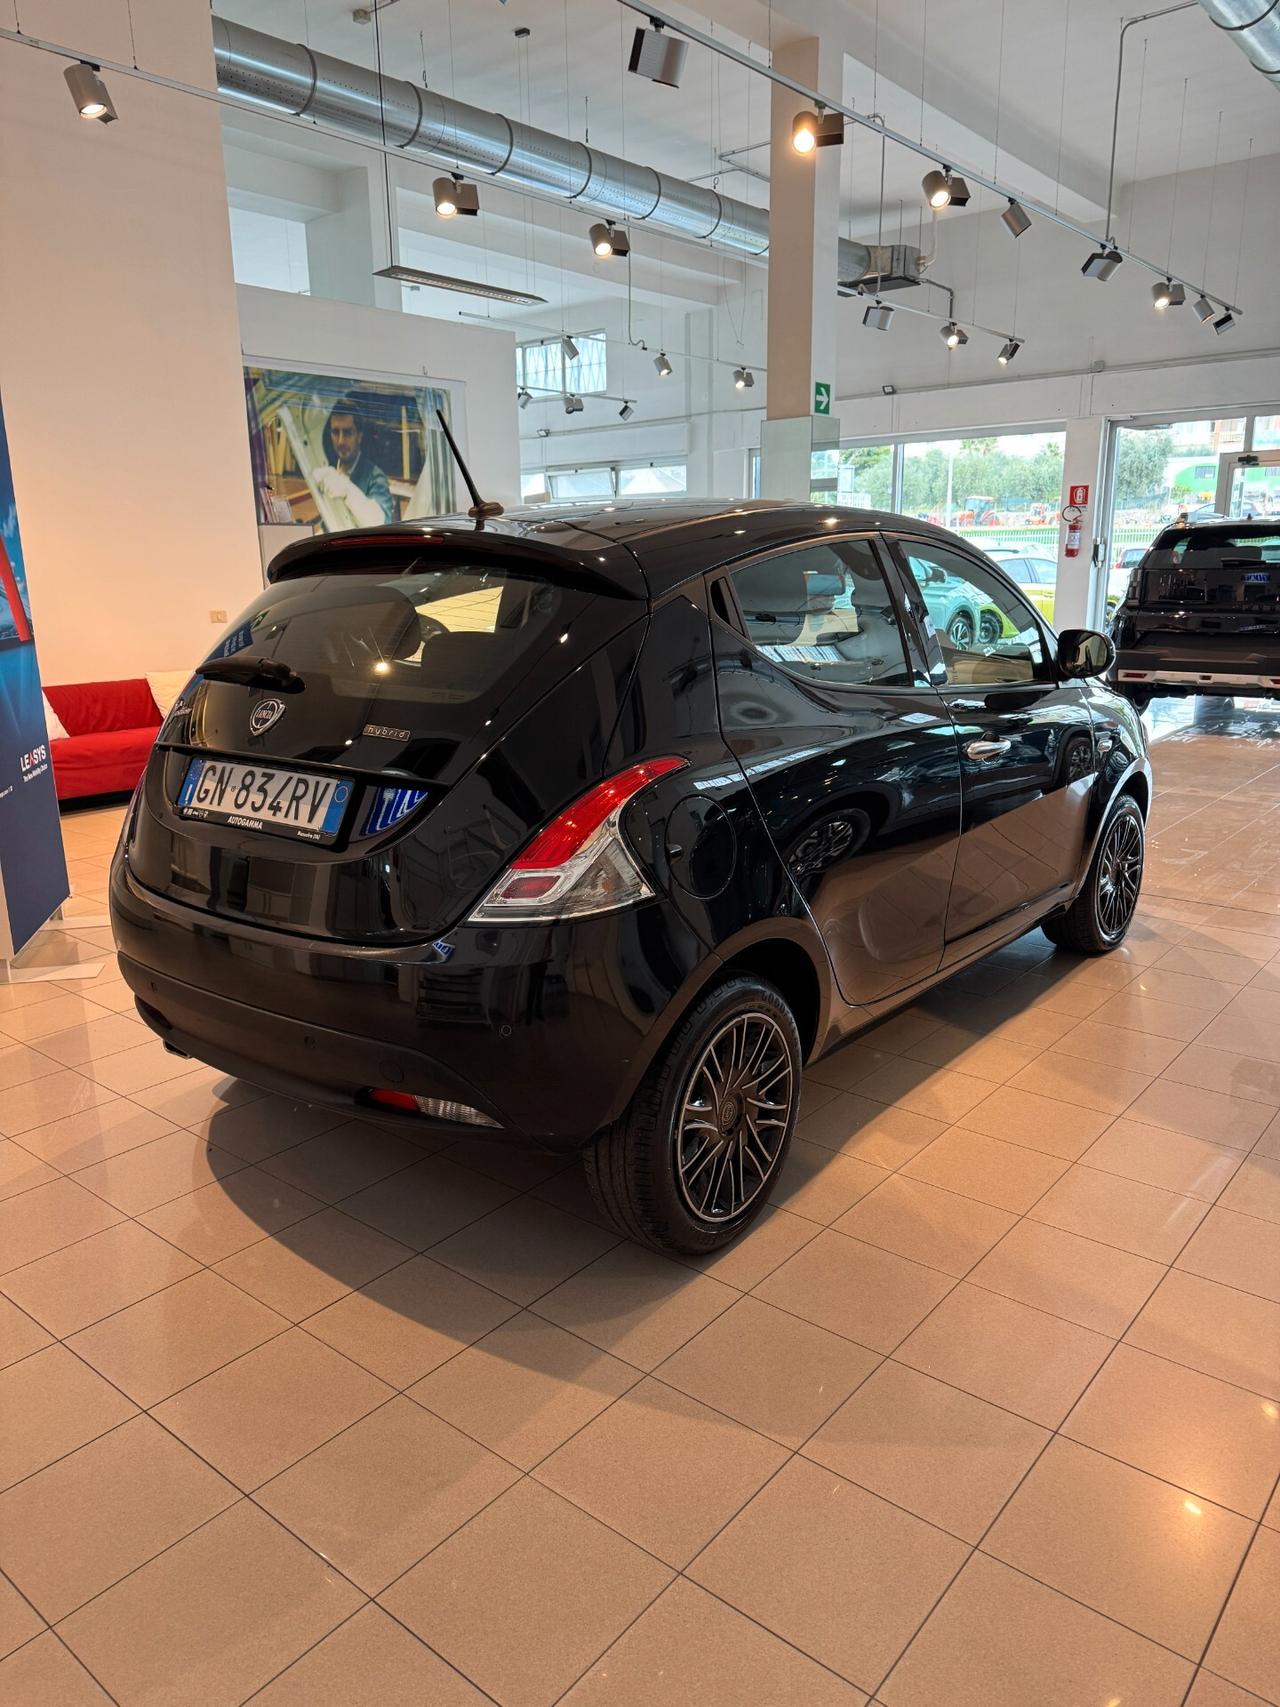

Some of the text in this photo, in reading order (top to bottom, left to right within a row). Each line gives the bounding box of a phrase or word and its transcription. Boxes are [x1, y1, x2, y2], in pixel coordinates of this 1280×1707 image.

[367, 726, 406, 739] hybrid
[20, 744, 47, 772] LEASYS
[227, 815, 263, 830] AUTOGAMMA
